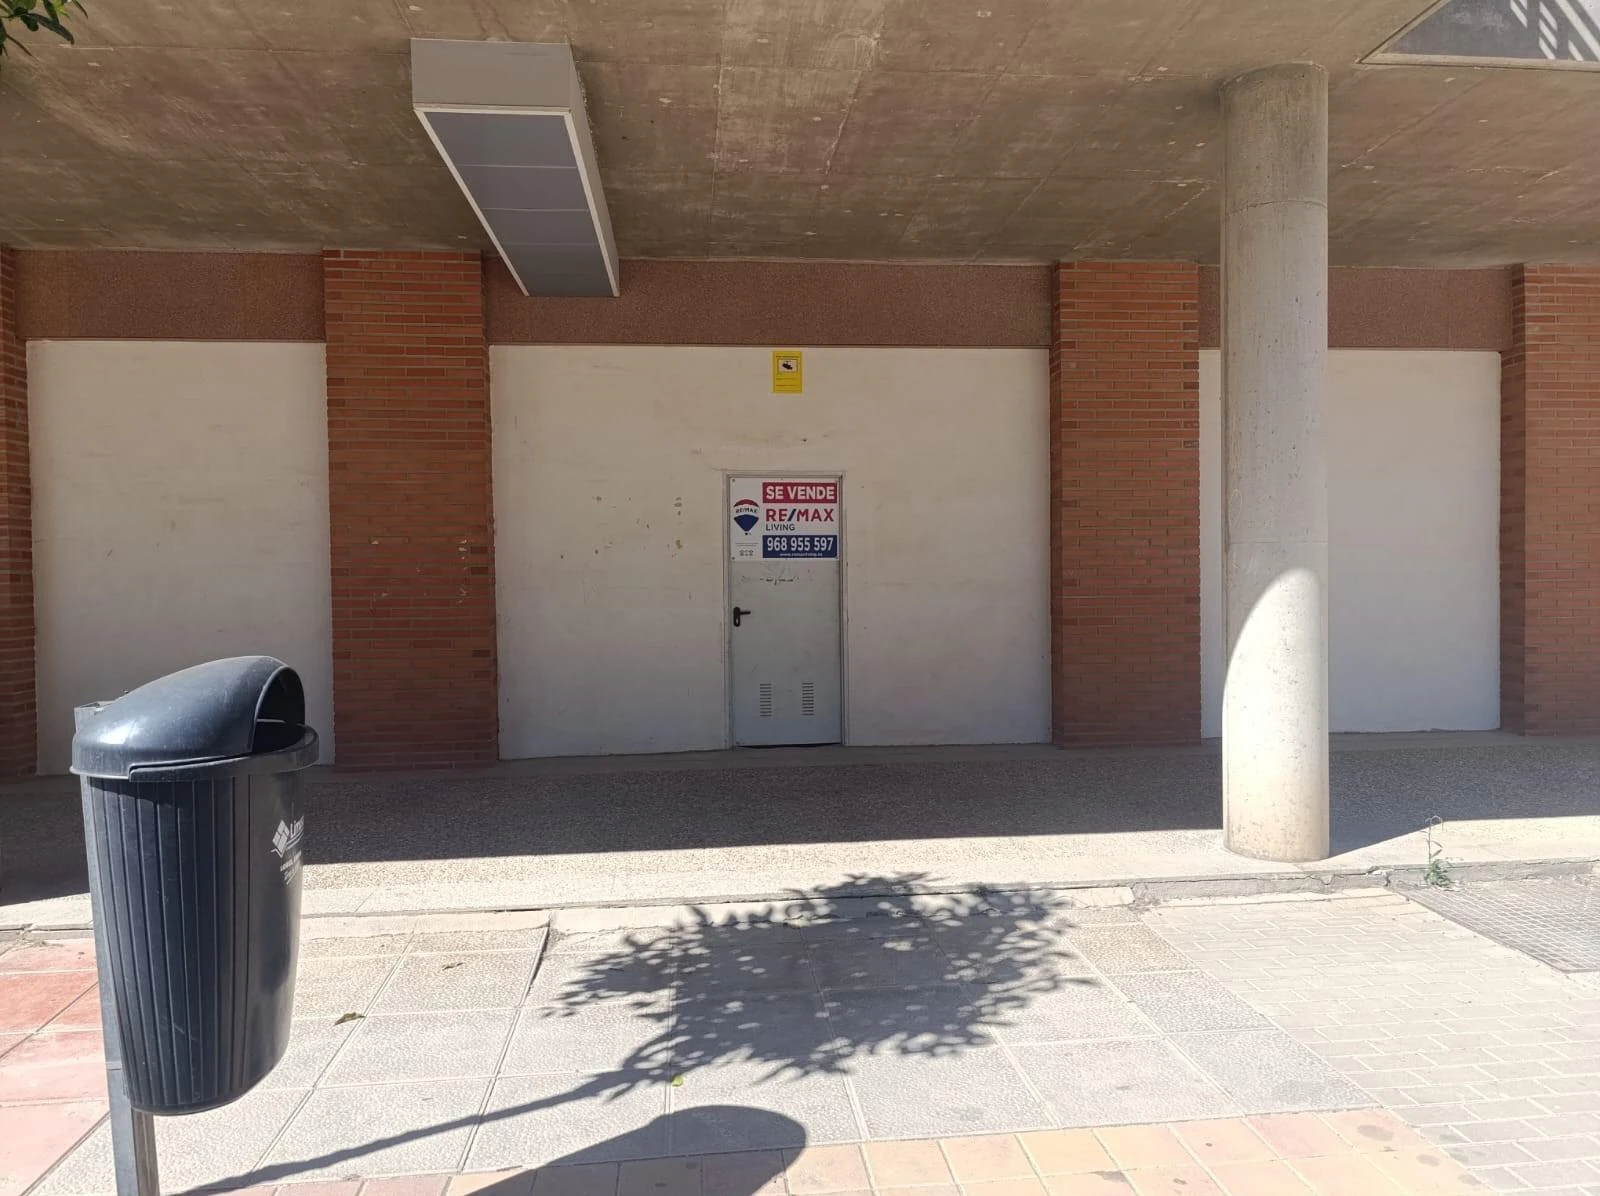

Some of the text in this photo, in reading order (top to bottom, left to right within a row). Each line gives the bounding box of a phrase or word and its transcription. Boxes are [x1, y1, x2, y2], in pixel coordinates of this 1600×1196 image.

[766, 486, 835, 500] SE VENDE
[765, 508, 834, 522] RE/MAX
[767, 537, 834, 551] 968 955 597
